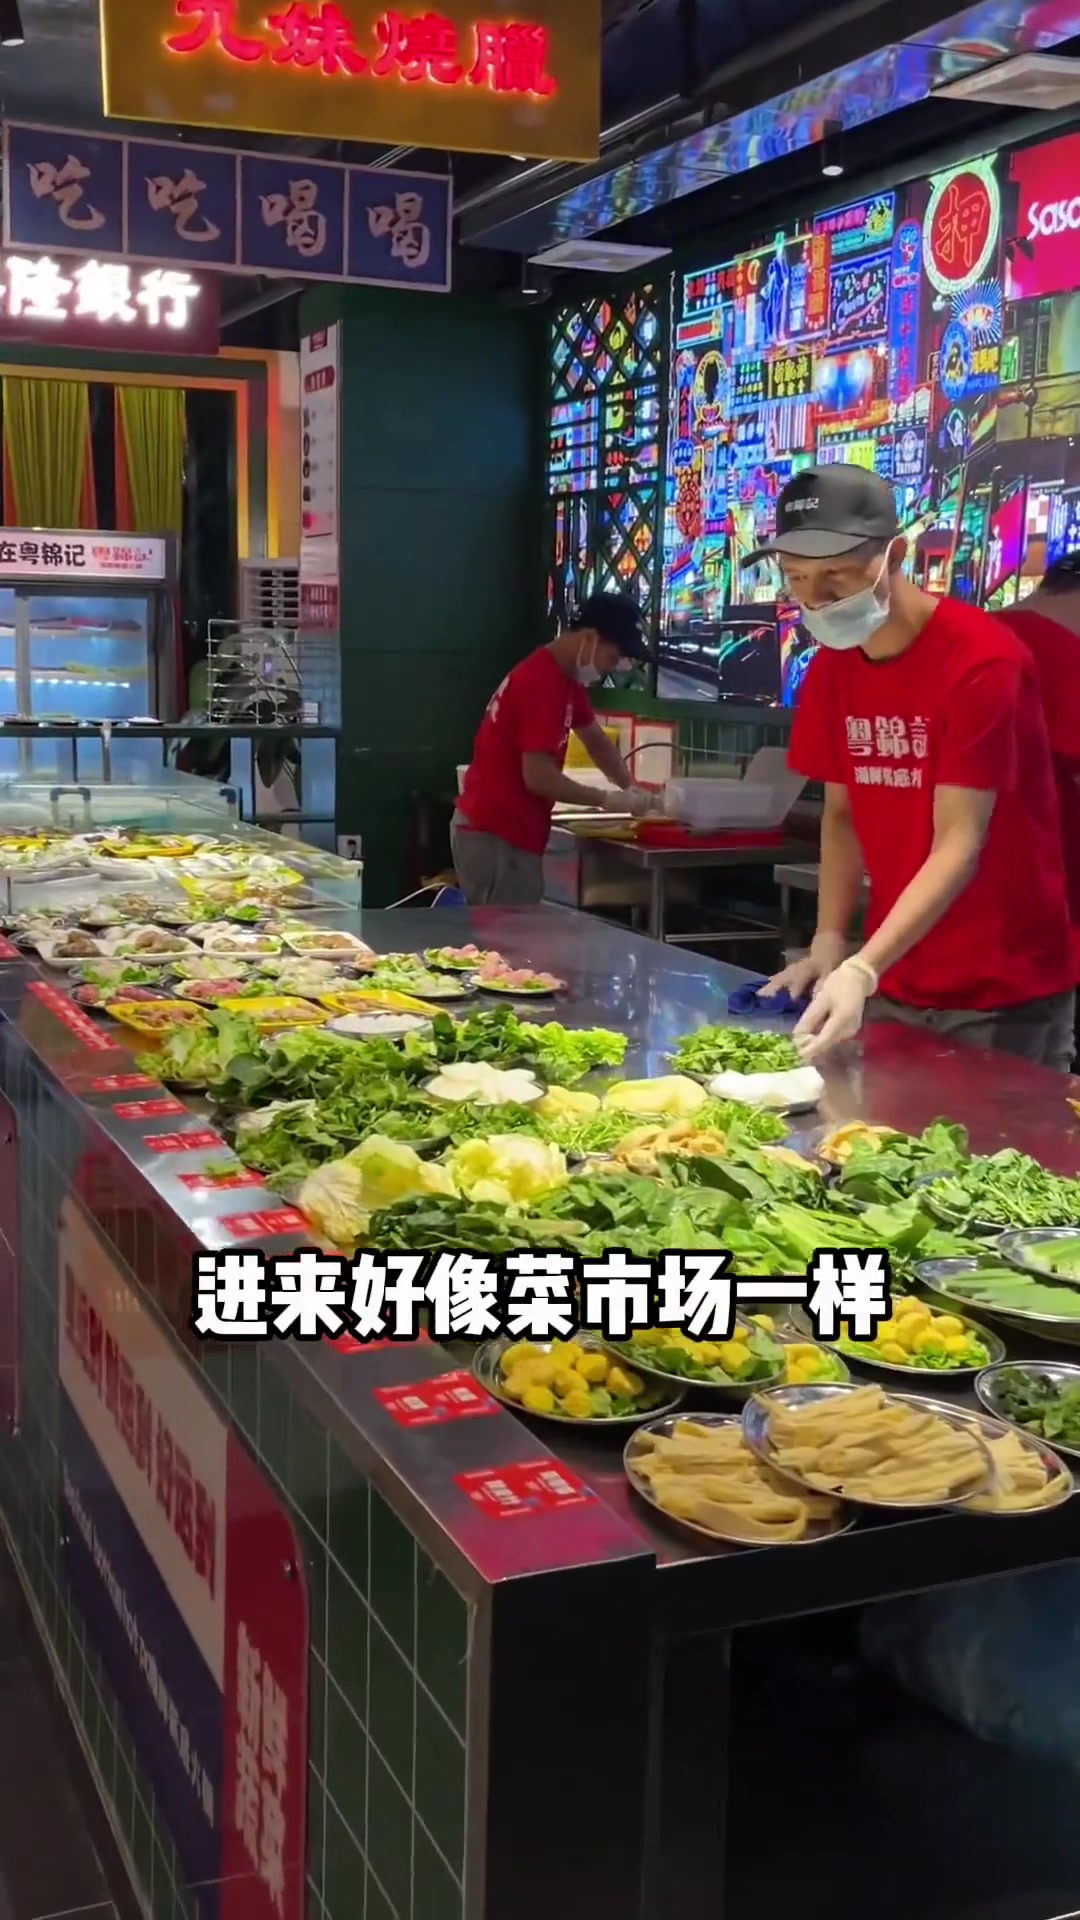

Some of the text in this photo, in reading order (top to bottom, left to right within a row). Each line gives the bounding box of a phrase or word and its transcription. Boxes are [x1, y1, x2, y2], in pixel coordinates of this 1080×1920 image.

[26, 154, 431, 268] 吃吃喝喝
[935, 184, 987, 269] 押
[0, 255, 201, 329] 隆銀行
